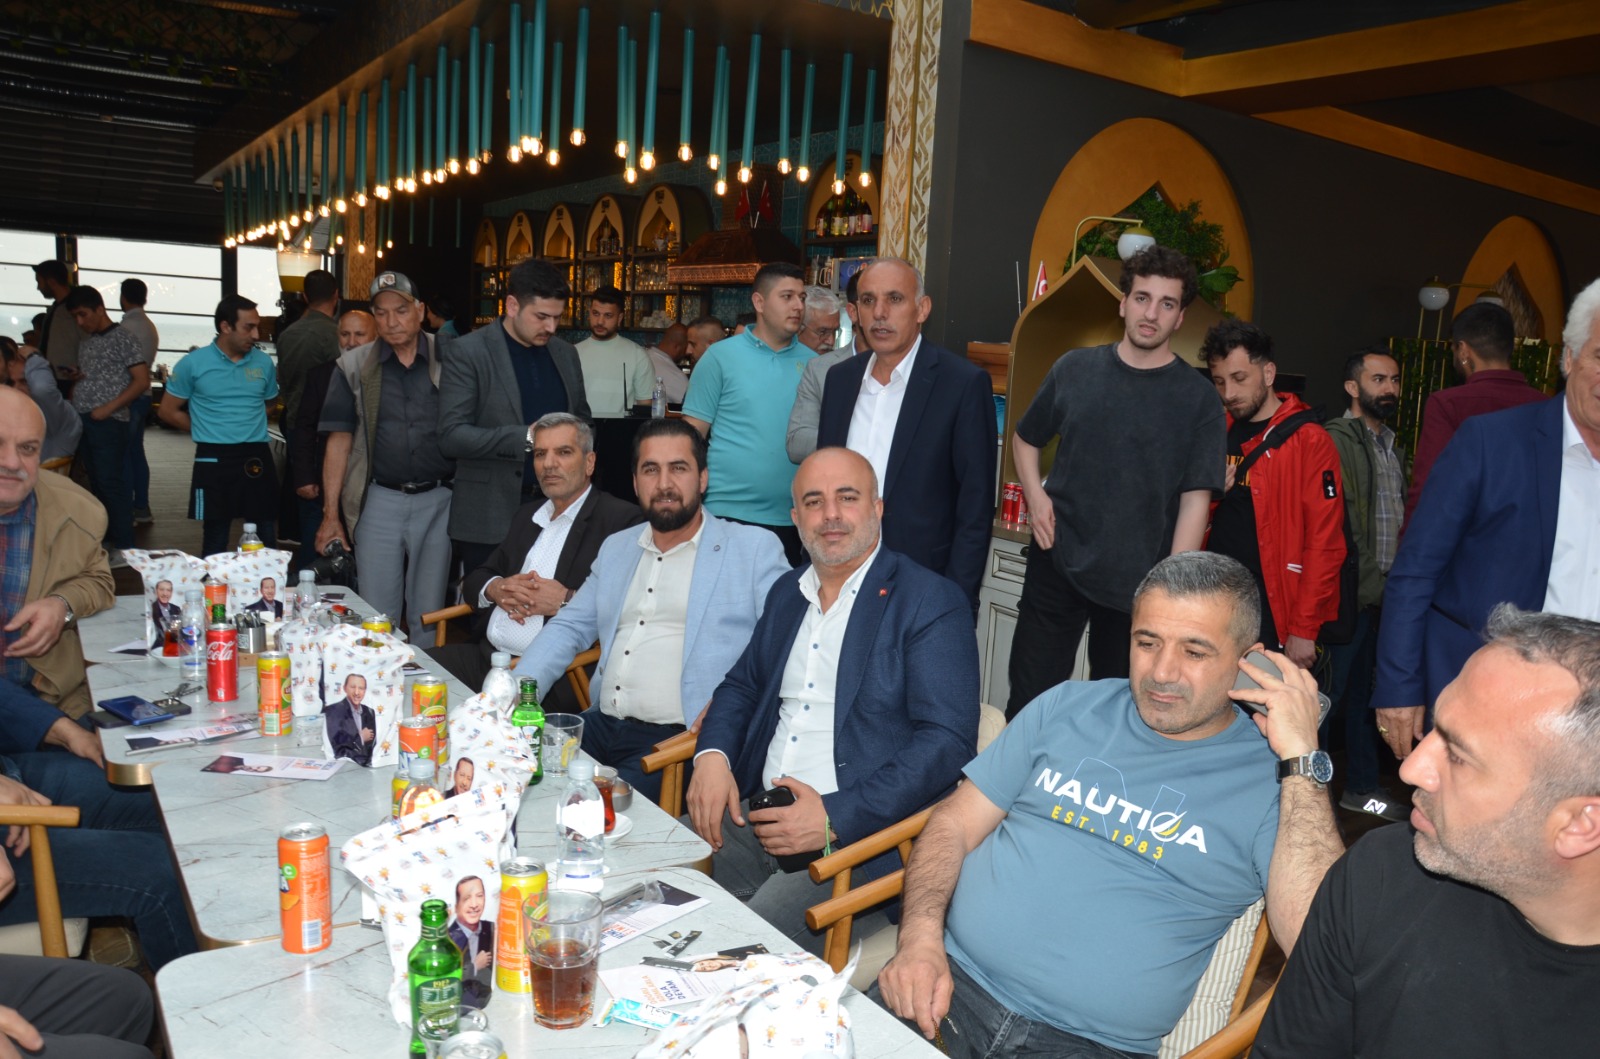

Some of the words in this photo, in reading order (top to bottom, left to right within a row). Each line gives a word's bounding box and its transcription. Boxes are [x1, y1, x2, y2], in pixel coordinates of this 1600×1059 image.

[1034, 767, 1208, 854] NAUTICA
[1051, 804, 1095, 834] EST.
[1111, 829, 1165, 860] 1983
[660, 986, 675, 1001] YOLA
[665, 980, 687, 1000] DEVAM
